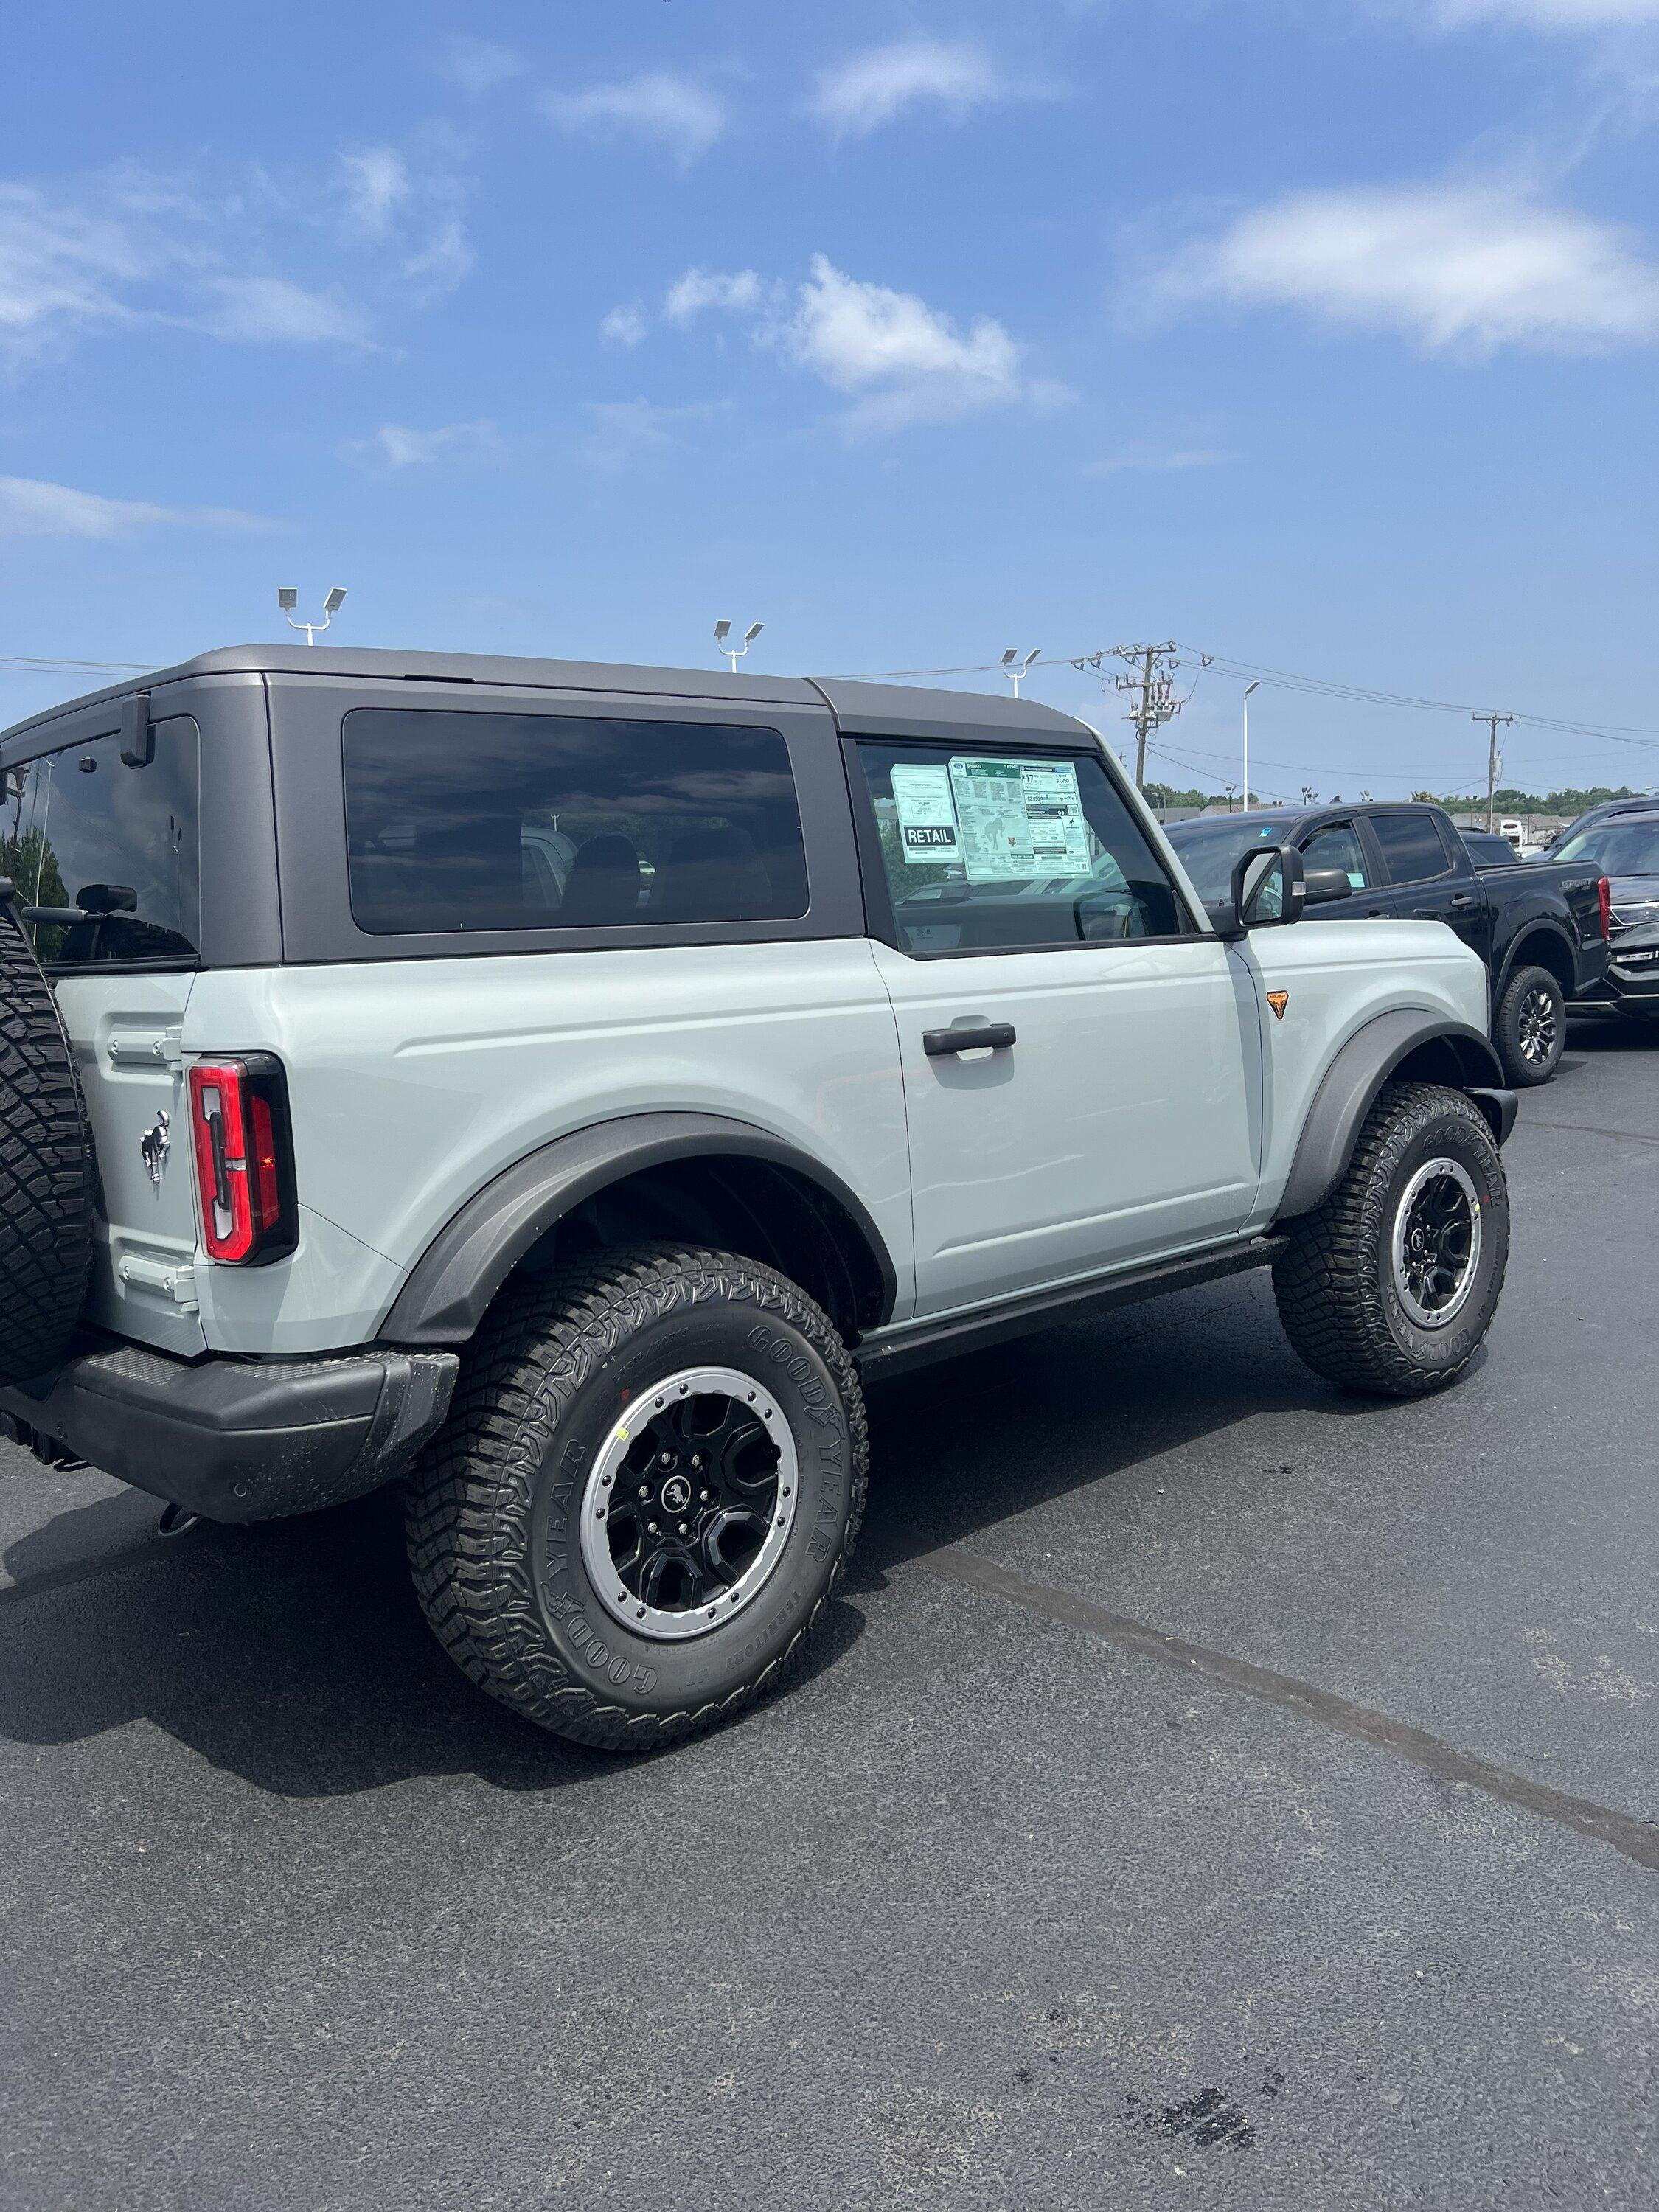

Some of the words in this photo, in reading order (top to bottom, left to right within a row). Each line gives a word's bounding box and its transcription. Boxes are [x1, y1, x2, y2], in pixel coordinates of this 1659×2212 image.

[1026, 774, 1033, 782] 17
[908, 830, 951, 843] RETAIL
[1559, 877, 1594, 890] SPORT
[1422, 1126, 1503, 1209] GOODYEAR
[1387, 1283, 1471, 1362] GOODYEAR
[748, 1324, 846, 1564] GOODYEAR
[540, 1439, 658, 1695] GOODYEAR
[725, 1590, 802, 1672] TERRITORY
